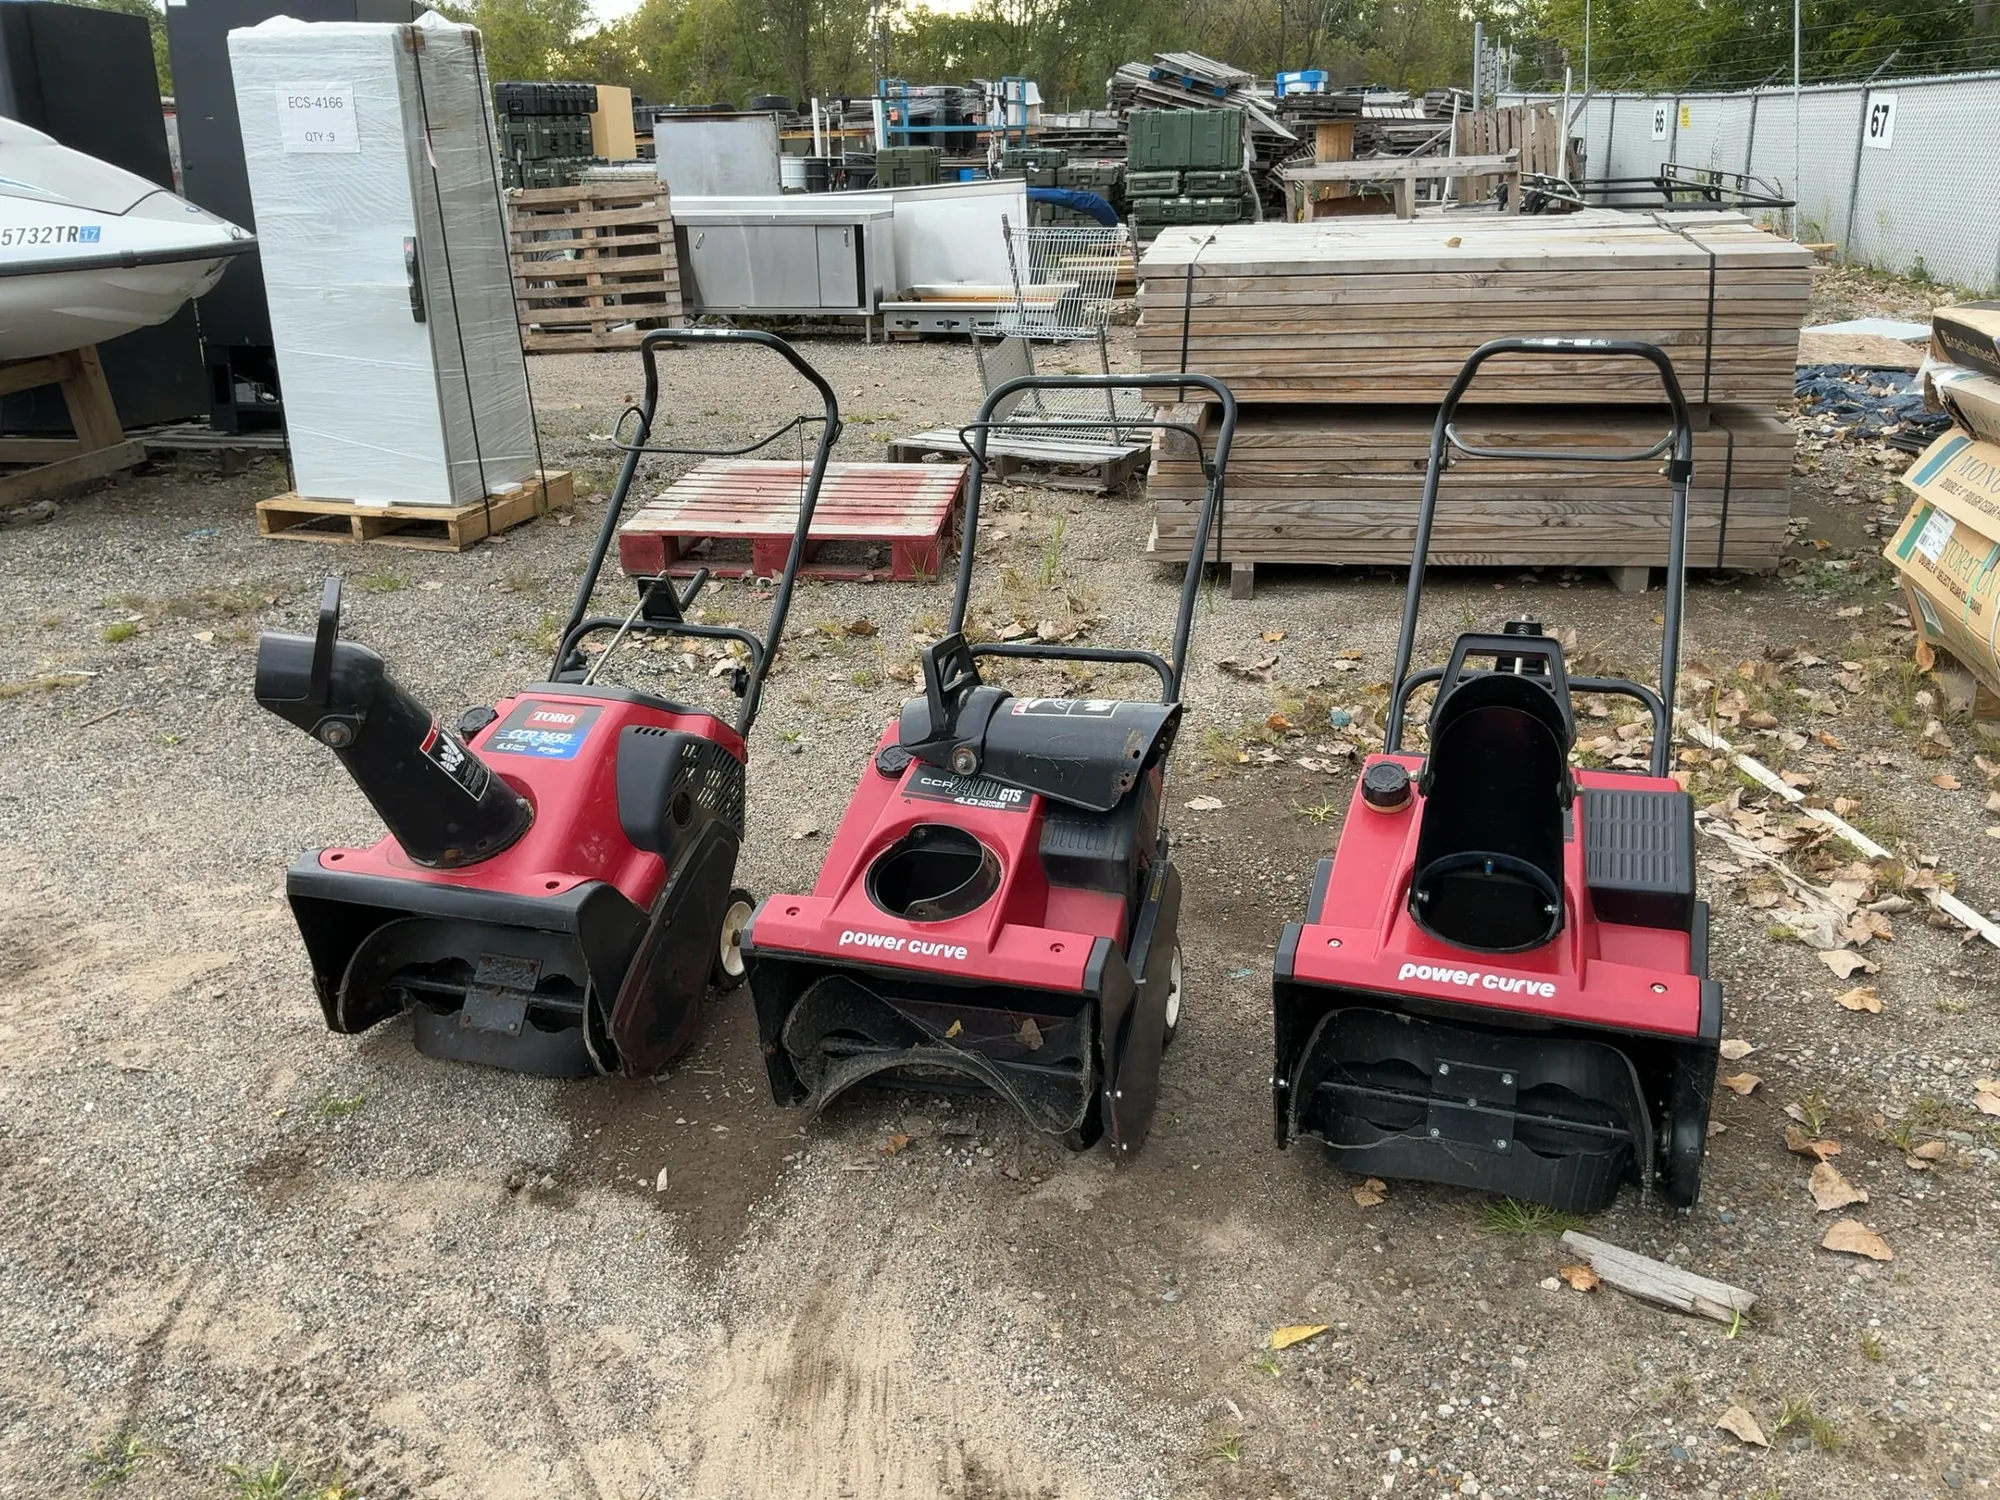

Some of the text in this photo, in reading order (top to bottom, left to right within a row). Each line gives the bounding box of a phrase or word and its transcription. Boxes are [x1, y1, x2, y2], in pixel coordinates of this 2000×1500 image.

[288, 96, 343, 109] ECS-4166
[1654, 109, 1665, 133] 66
[1870, 103, 1890, 138] 67
[304, 131, 323, 143] QTY
[1, 225, 79, 246] 5732TR
[81, 227, 99, 240] 17
[532, 711, 576, 724] TORO
[507, 728, 573, 744] CCR 3650
[920, 774, 1022, 803] CCR 2400 GTS
[953, 796, 978, 806] 4.0
[839, 930, 968, 960] power curve
[1398, 963, 1556, 998] power curve
